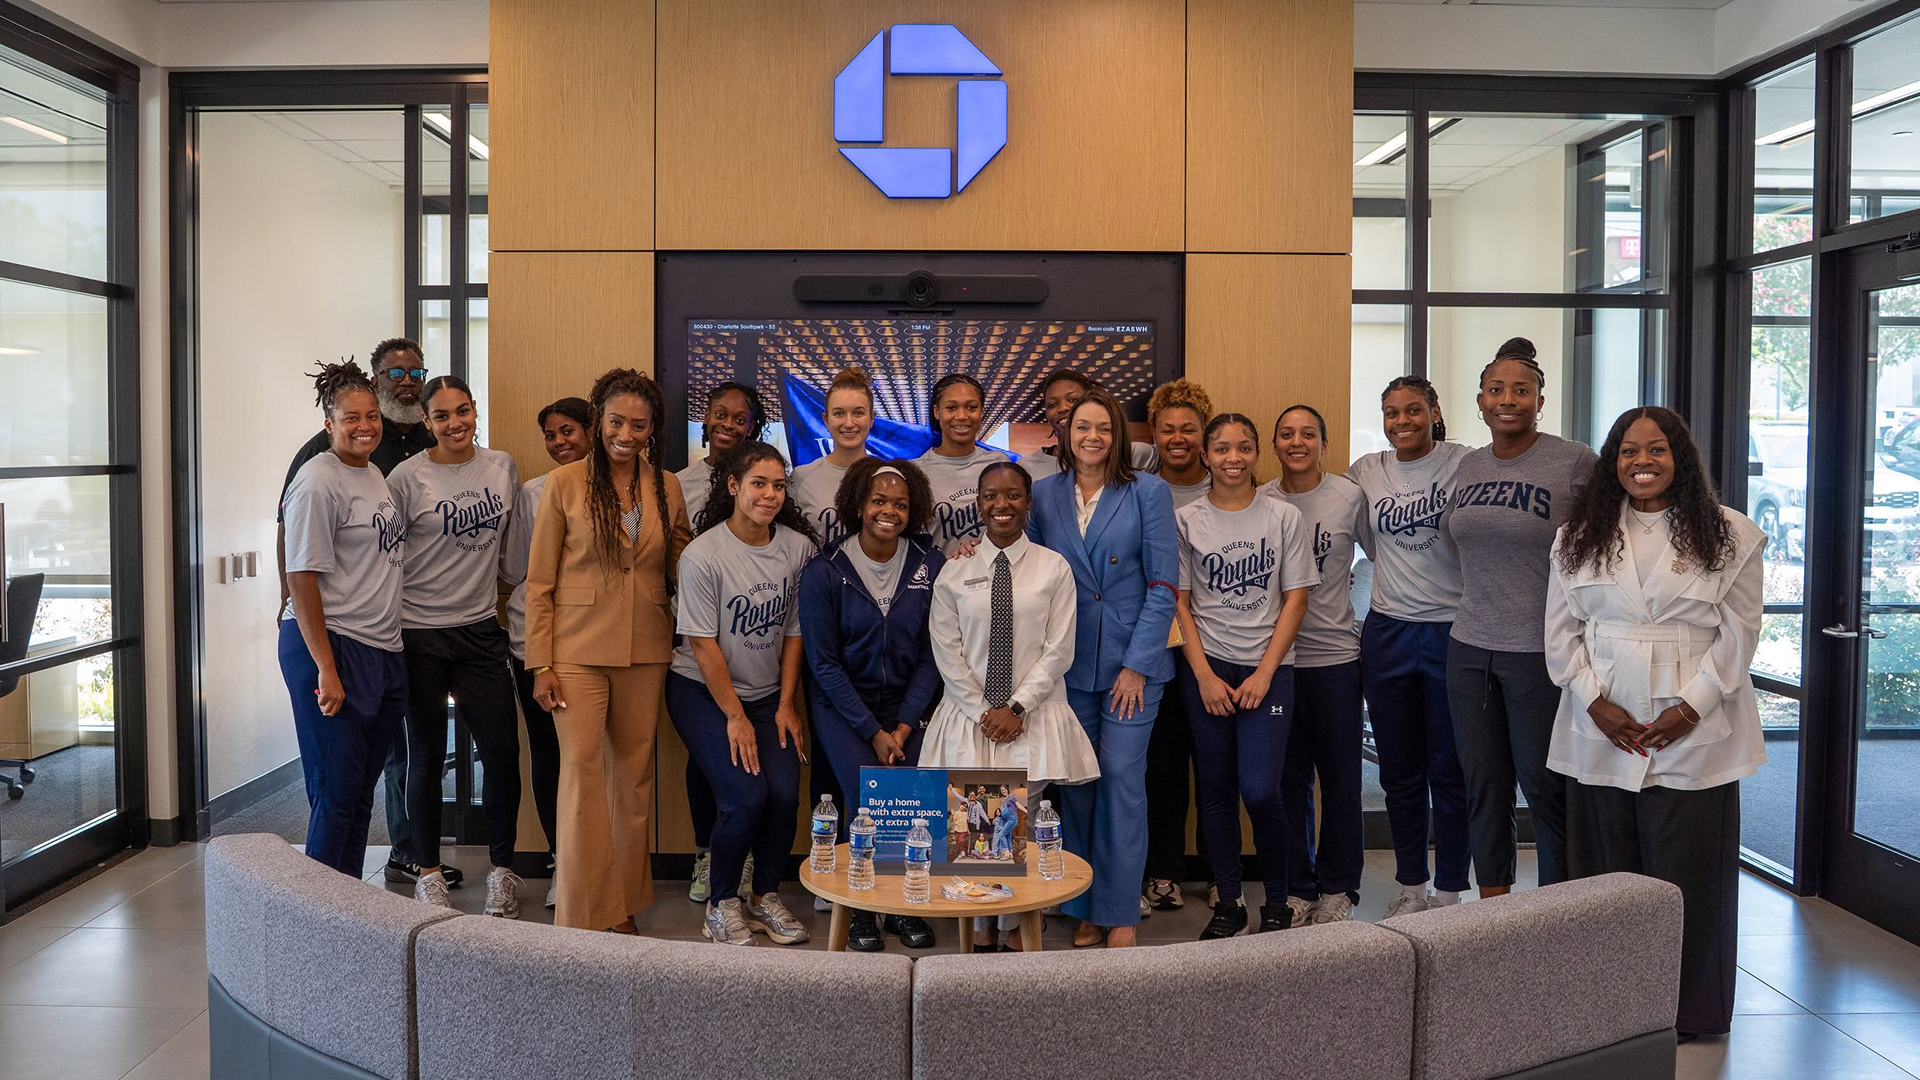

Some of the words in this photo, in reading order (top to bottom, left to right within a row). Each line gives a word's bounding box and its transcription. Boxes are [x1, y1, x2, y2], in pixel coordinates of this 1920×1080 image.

[740, 323, 764, 331] Southpark
[452, 490, 481, 501] QUEENS
[434, 486, 503, 539] Royals
[1374, 481, 1448, 537] Royals
[932, 501, 985, 540] Roy
[1423, 516, 1437, 527] CLT
[455, 535, 497, 552] UNIVERSITY
[1221, 541, 1256, 554] QUEENS
[1394, 533, 1440, 551] UNIVERSITY
[1201, 536, 1276, 597] Royals
[1253, 575, 1267, 586] CLT
[726, 576, 794, 637] Royals
[1221, 594, 1268, 612] UNIVERSITY
[868, 797, 886, 808] Buy
[895, 797, 921, 807] home
[869, 807, 889, 816] with
[891, 809, 914, 817] extra
[916, 809, 944, 818] space,
[911, 818, 930, 827] fs
